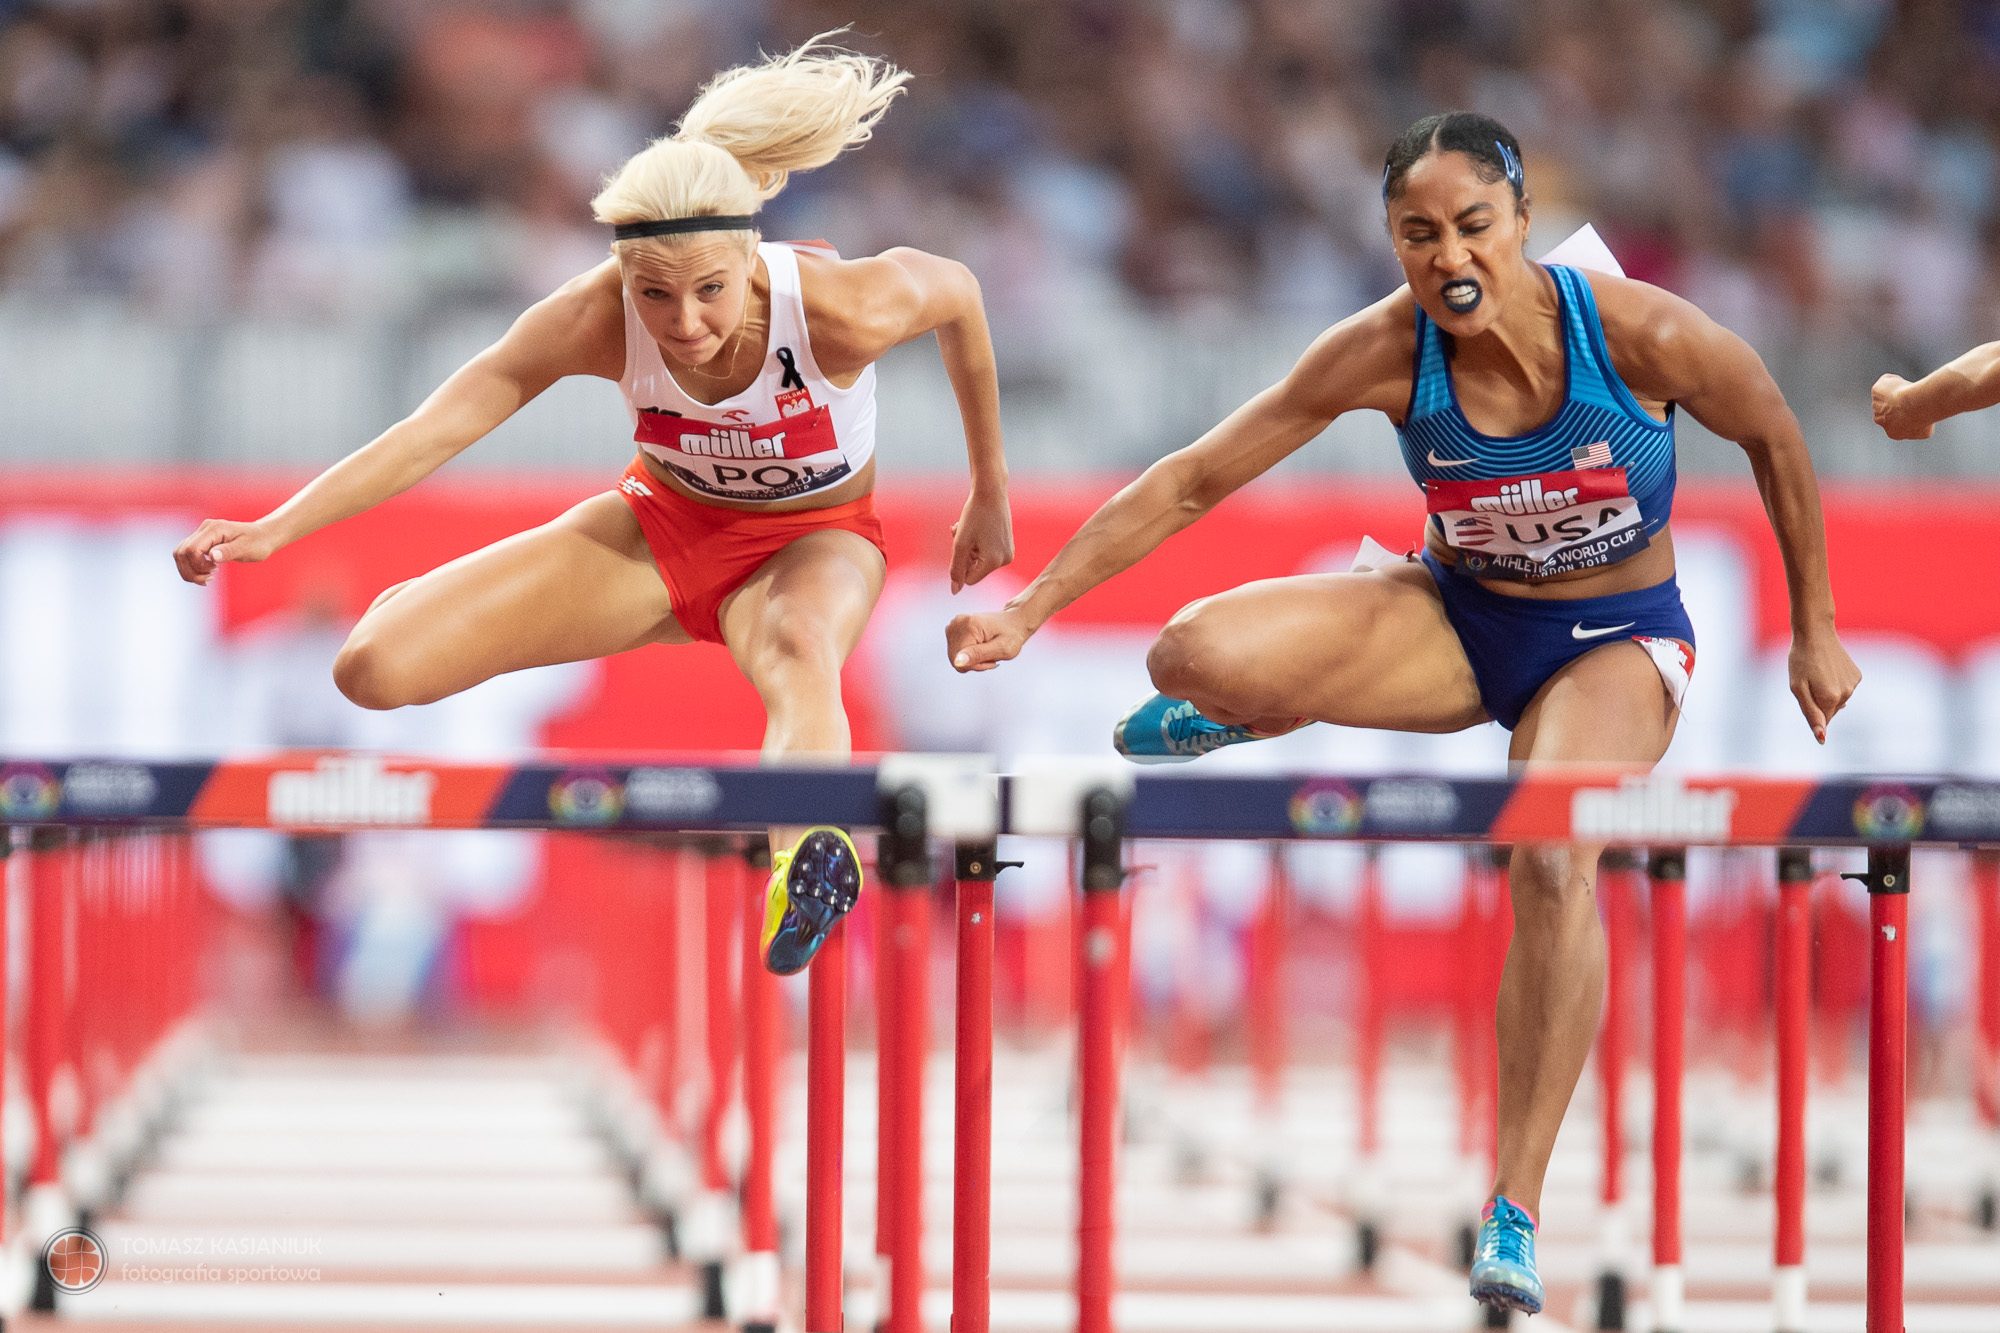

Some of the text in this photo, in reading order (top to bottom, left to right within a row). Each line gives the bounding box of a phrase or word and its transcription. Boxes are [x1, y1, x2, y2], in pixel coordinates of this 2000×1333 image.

[777, 388, 807, 401] POLSKA
[679, 427, 786, 459] müller
[1470, 478, 1579, 516] müller
[1505, 507, 1624, 544] USA
[1493, 529, 1637, 574] ATHLETIS WORLD CUP
[1579, 554, 1608, 569] 2018
